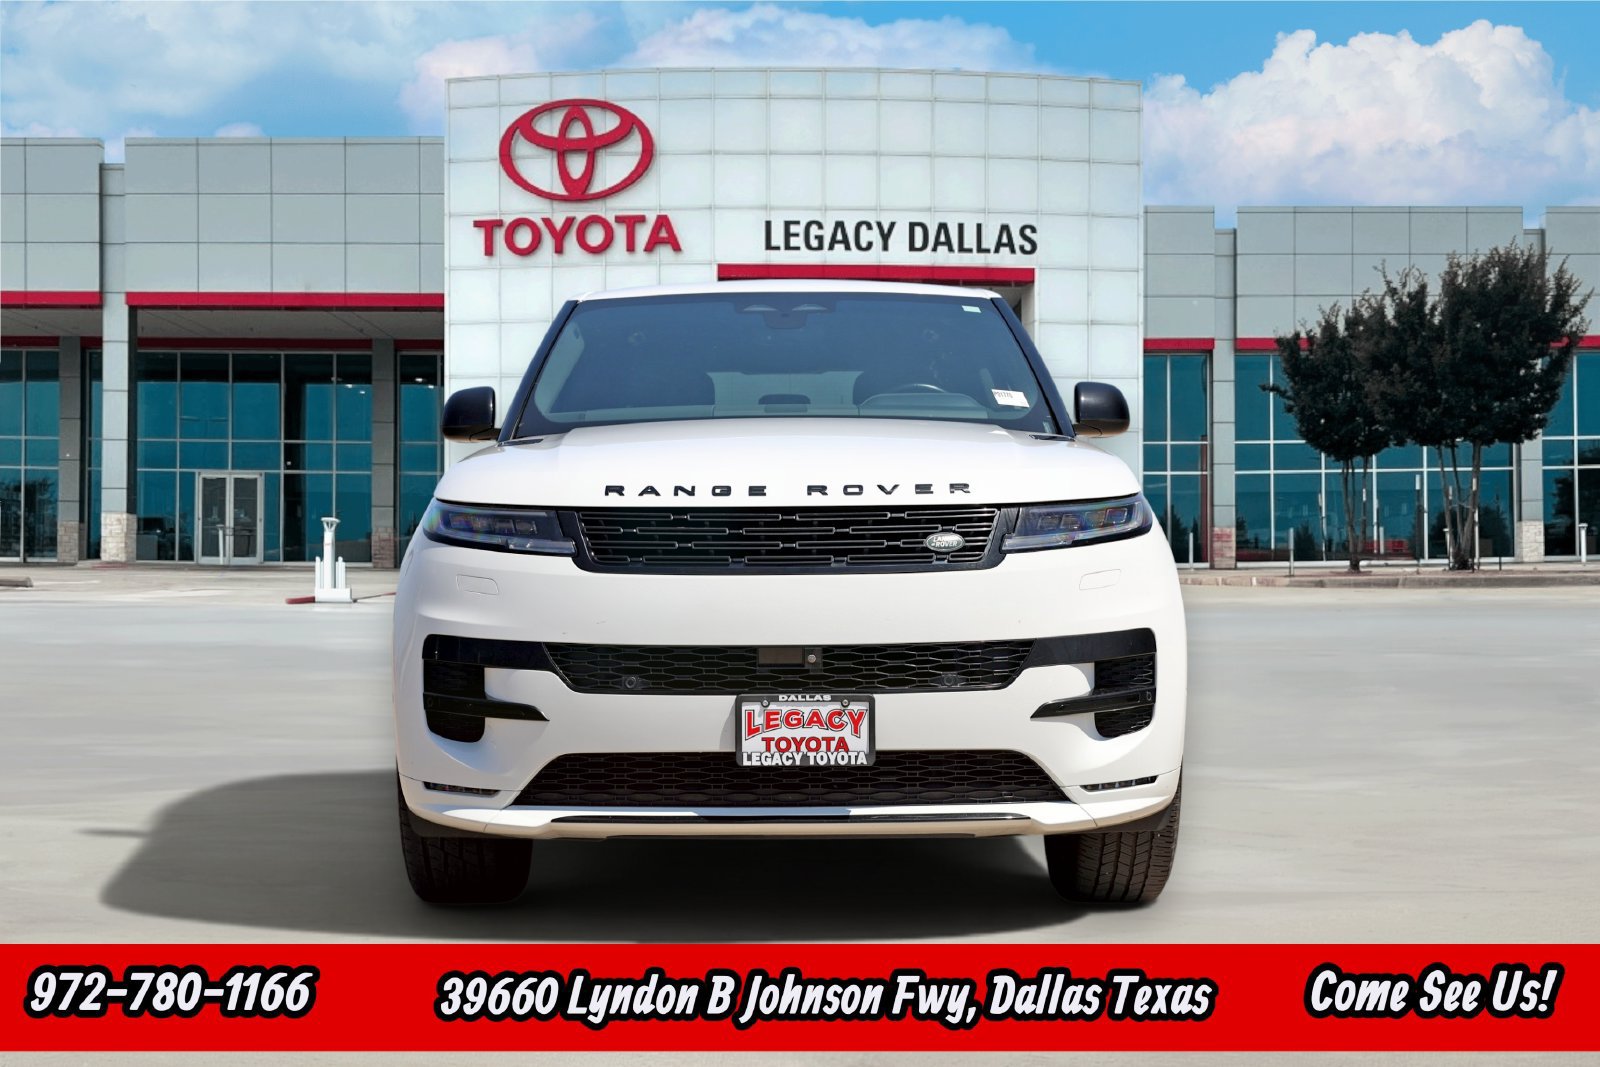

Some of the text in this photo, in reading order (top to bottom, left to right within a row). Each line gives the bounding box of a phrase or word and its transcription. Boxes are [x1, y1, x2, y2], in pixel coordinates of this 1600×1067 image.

[474, 214, 682, 257] TOYOTA
[765, 220, 1038, 255] LEGACY DALLAS
[604, 483, 971, 497] RANGE ROVER
[778, 694, 832, 702] DALLAS
[745, 709, 868, 741] LEGACY
[761, 736, 850, 753] TOYOTA
[742, 751, 868, 767] LEGACY TOYOTA
